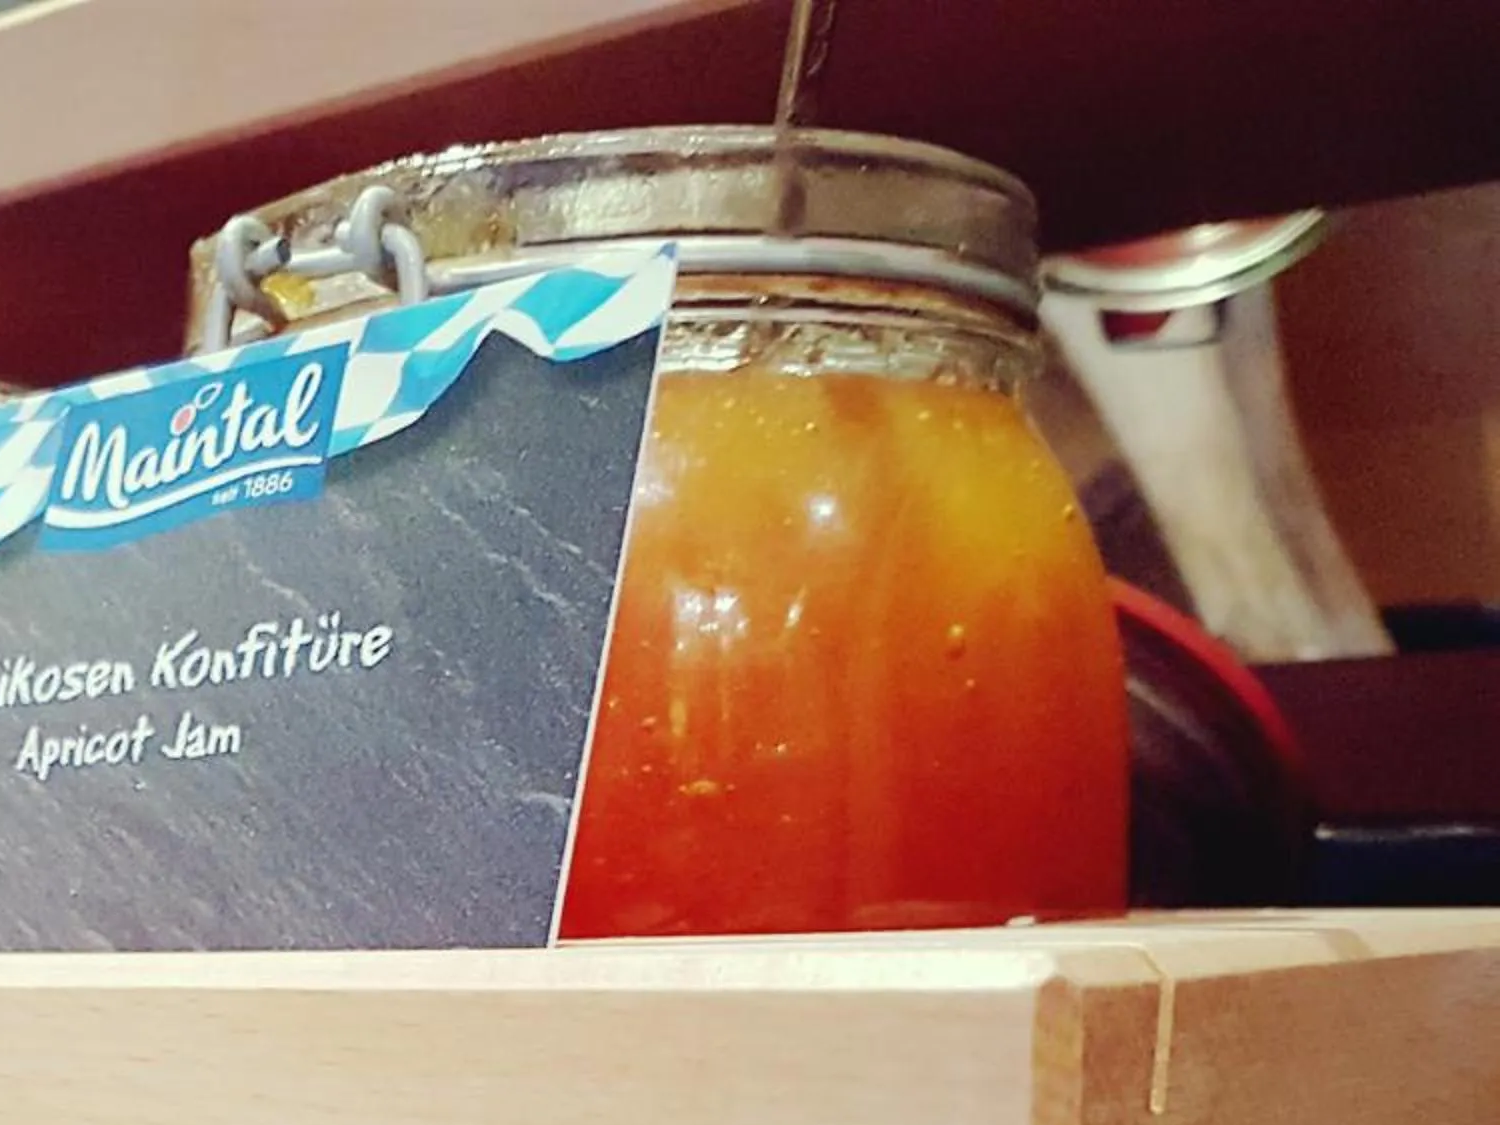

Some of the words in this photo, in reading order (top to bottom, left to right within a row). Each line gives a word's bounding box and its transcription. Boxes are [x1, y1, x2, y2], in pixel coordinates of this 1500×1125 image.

[60, 362, 324, 511] Maintal
[243, 469, 294, 499] 1886
[150, 610, 394, 691] Konfitüre
[14, 714, 155, 781] Apricot
[160, 710, 241, 760] Jam
